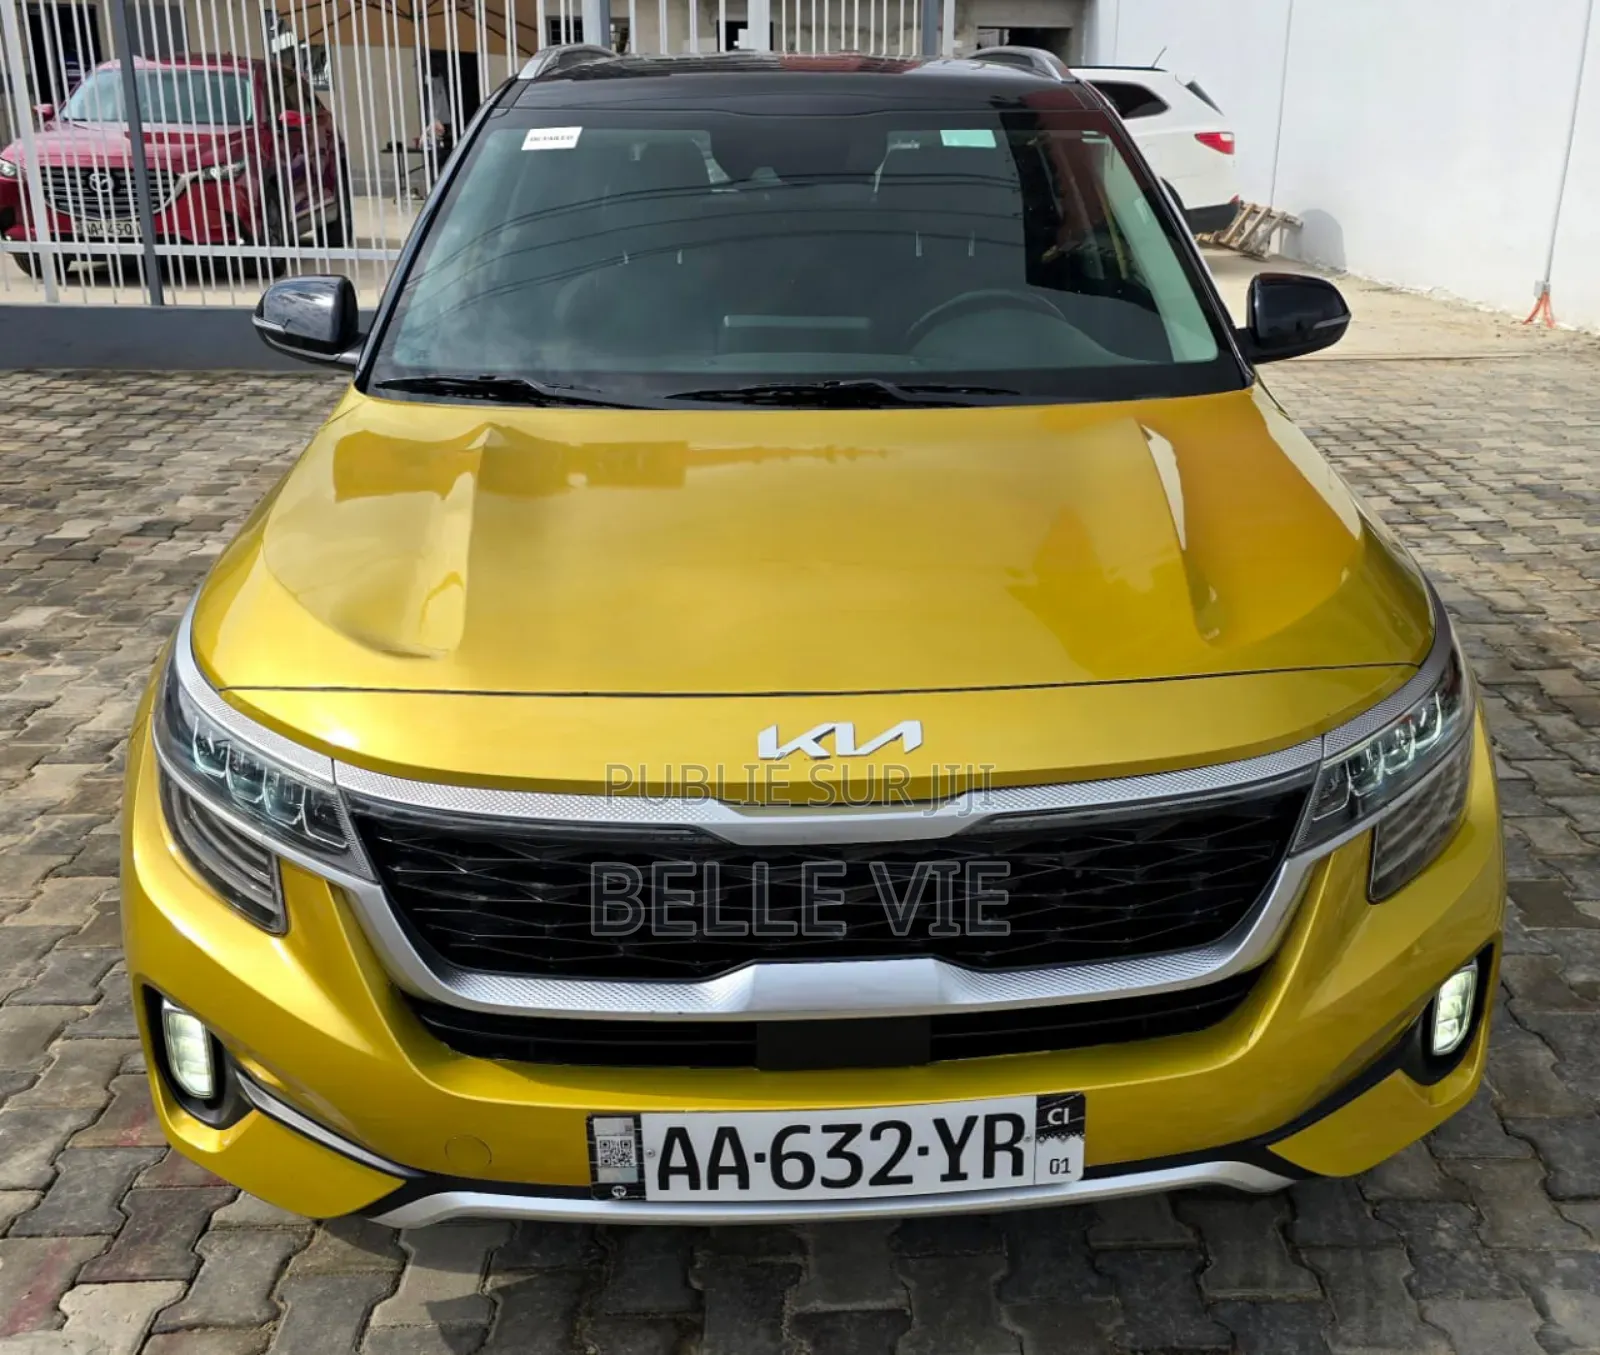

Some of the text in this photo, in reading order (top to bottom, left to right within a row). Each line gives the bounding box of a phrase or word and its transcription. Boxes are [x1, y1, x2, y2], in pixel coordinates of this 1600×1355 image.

[758, 720, 923, 760] KIA
[1047, 1107, 1070, 1125] CI
[1049, 1157, 1072, 1175] 01
